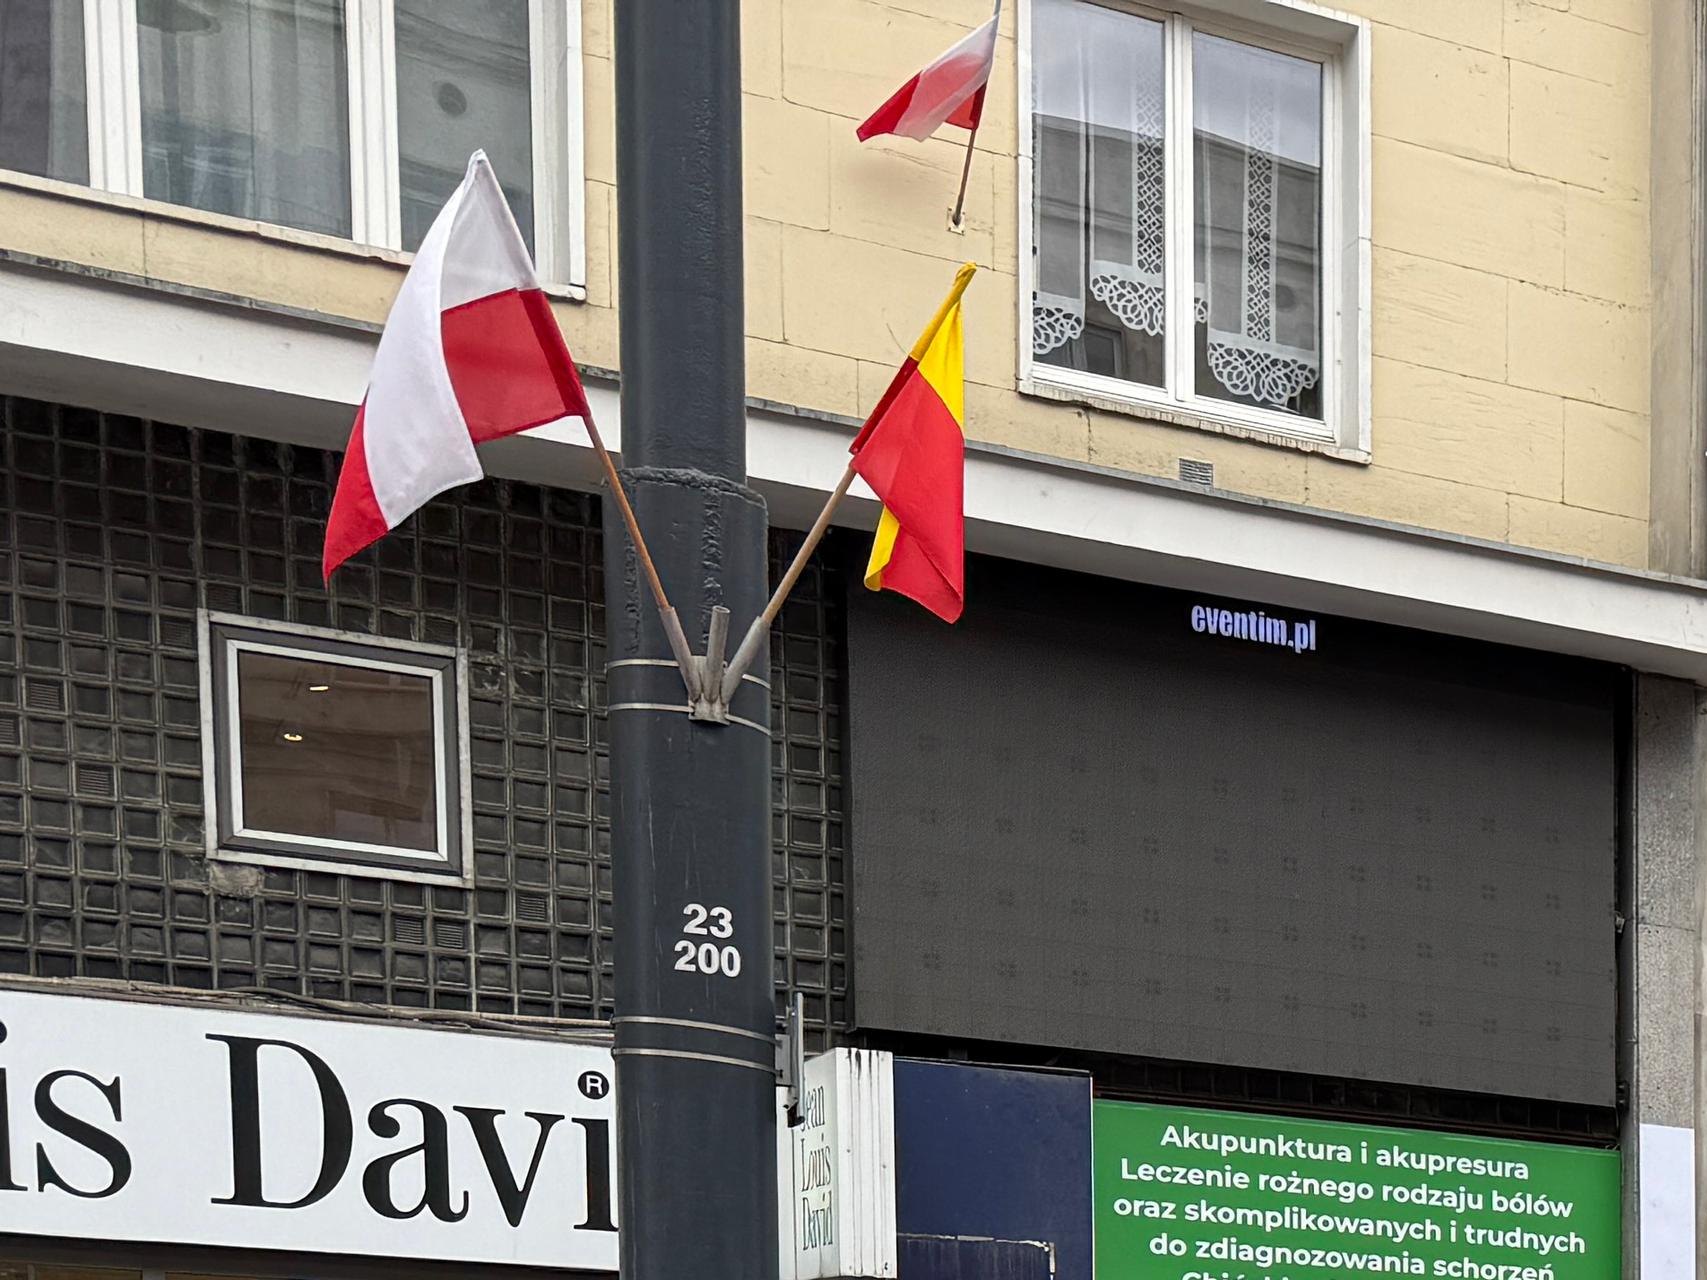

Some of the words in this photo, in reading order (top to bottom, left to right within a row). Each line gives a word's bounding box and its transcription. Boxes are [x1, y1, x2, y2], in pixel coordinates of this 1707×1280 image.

[1191, 605, 1316, 654] eventim.pl
[683, 903, 733, 939] 23
[674, 939, 741, 977] 200
[801, 1132, 831, 1192] Louis
[1160, 1124, 1353, 1164] Akupunktura
[1360, 1141, 1368, 1164] i
[1376, 1144, 1529, 1180] akupresura
[1120, 1158, 1250, 1190] Leczenie
[1258, 1171, 1374, 1202] rożnego
[1382, 1180, 1484, 1214] rodzaju
[1492, 1189, 1574, 1218] bólów
[802, 1190, 834, 1250] David
[1113, 1199, 1177, 1220] oraz
[1184, 1201, 1441, 1245] skomplikowanych
[1450, 1219, 1456, 1243] i
[1465, 1223, 1586, 1256] trudnych
[1149, 1233, 1187, 1257] do
[1195, 1236, 1425, 1275] zdiagnozowania
